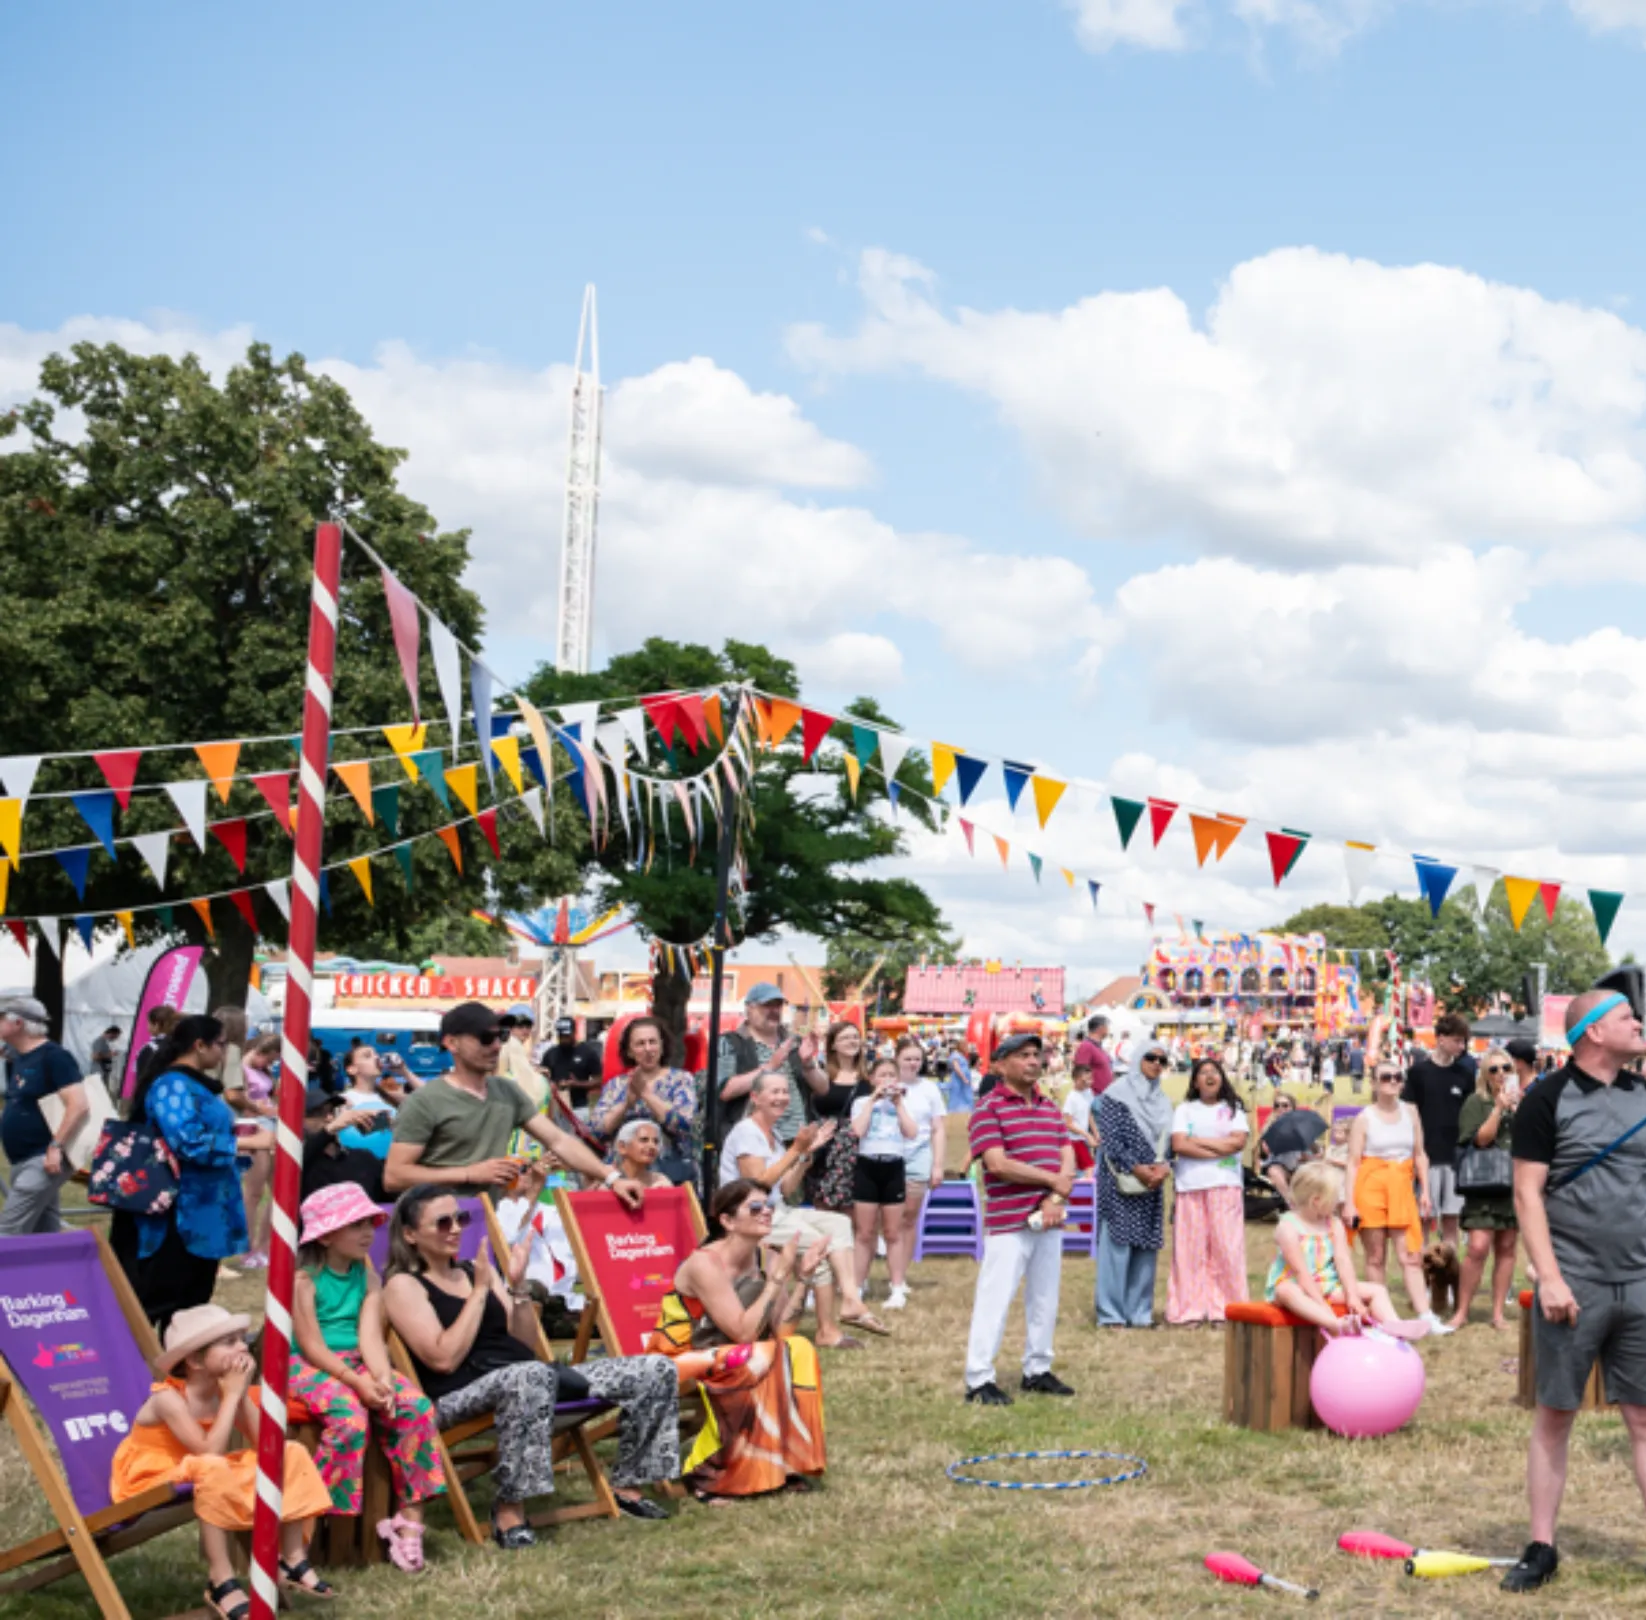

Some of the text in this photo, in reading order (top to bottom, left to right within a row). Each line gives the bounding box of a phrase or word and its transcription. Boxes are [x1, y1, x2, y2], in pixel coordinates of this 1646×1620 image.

[338, 974, 531, 998] CHICKEN SHACK
[604, 1232, 656, 1250] Barking
[609, 1245, 675, 1262] Dagenham
[0, 1292, 66, 1312] Barking
[7, 1308, 90, 1329] Dagenham
